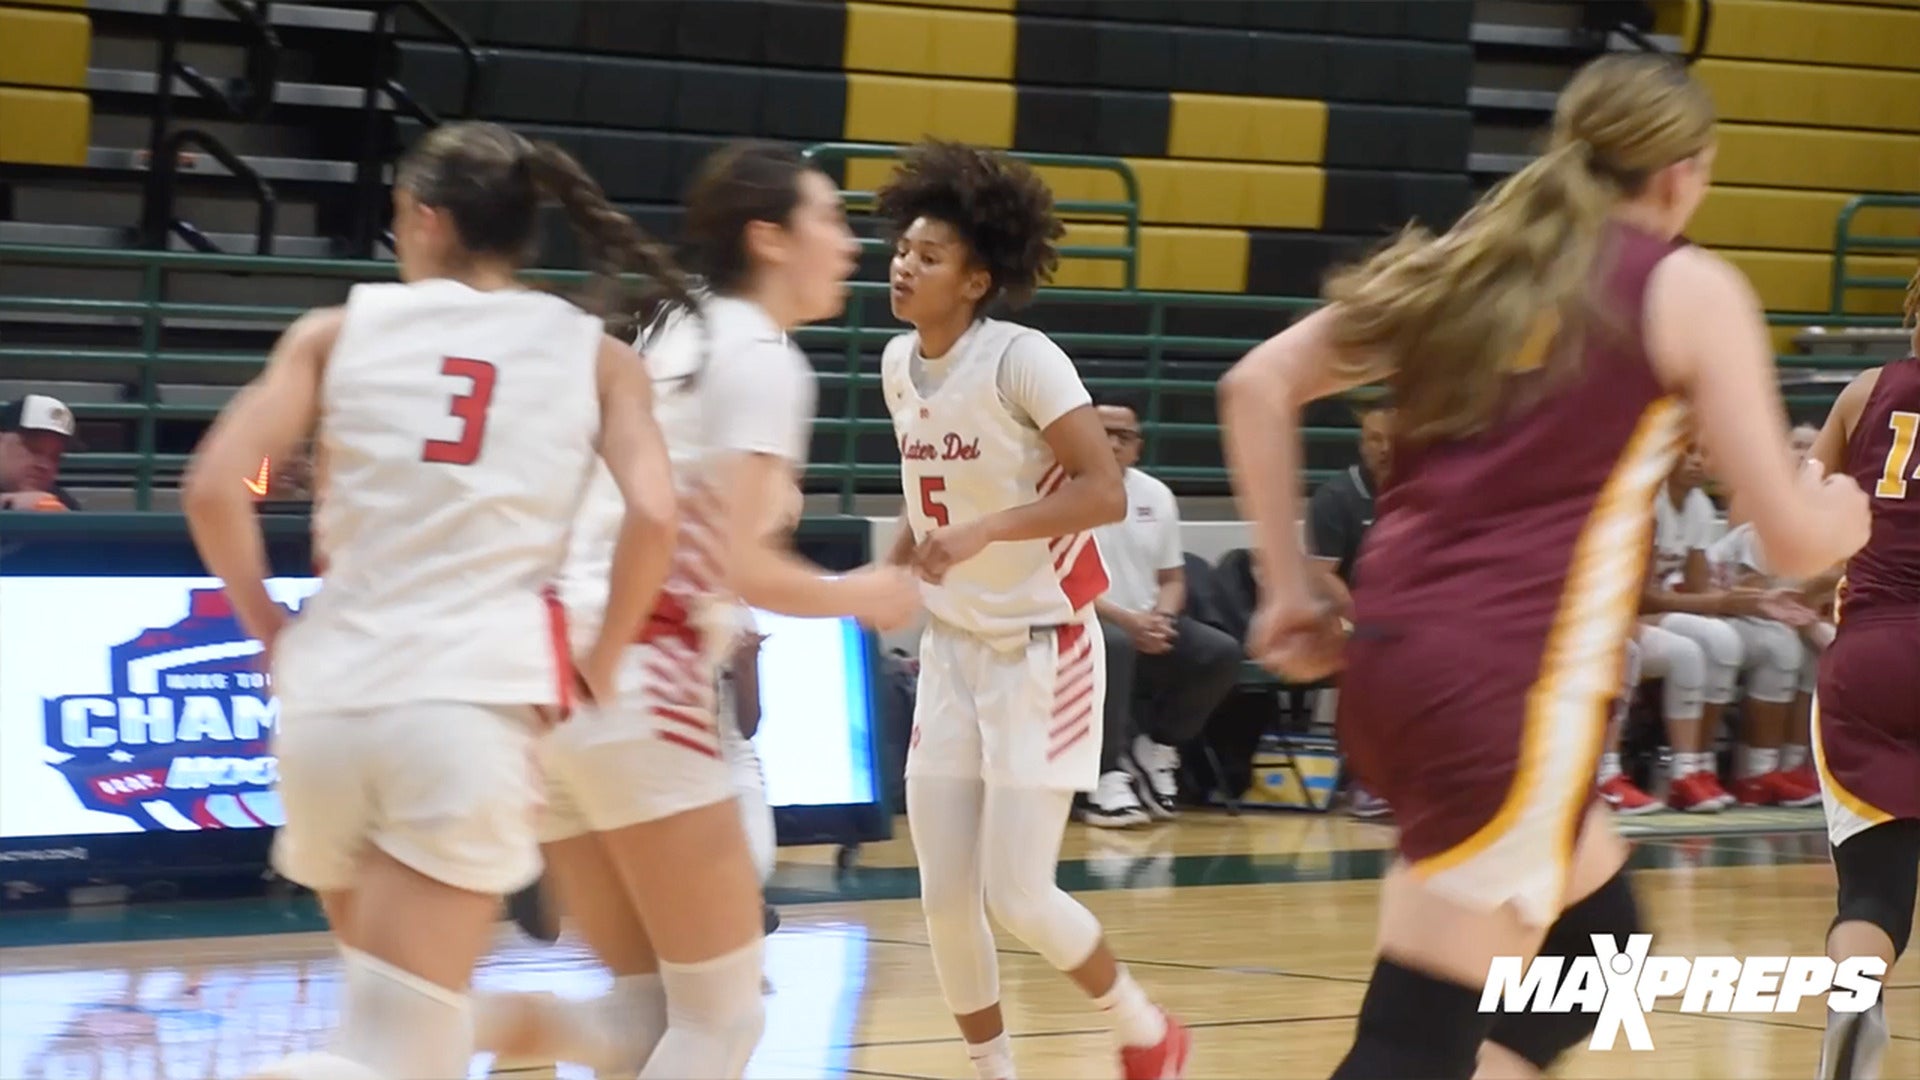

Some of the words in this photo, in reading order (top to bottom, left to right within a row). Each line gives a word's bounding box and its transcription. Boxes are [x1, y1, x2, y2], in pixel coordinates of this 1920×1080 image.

[421, 356, 496, 465] 3
[1875, 411, 1920, 499] 1
[920, 476, 949, 530] 5
